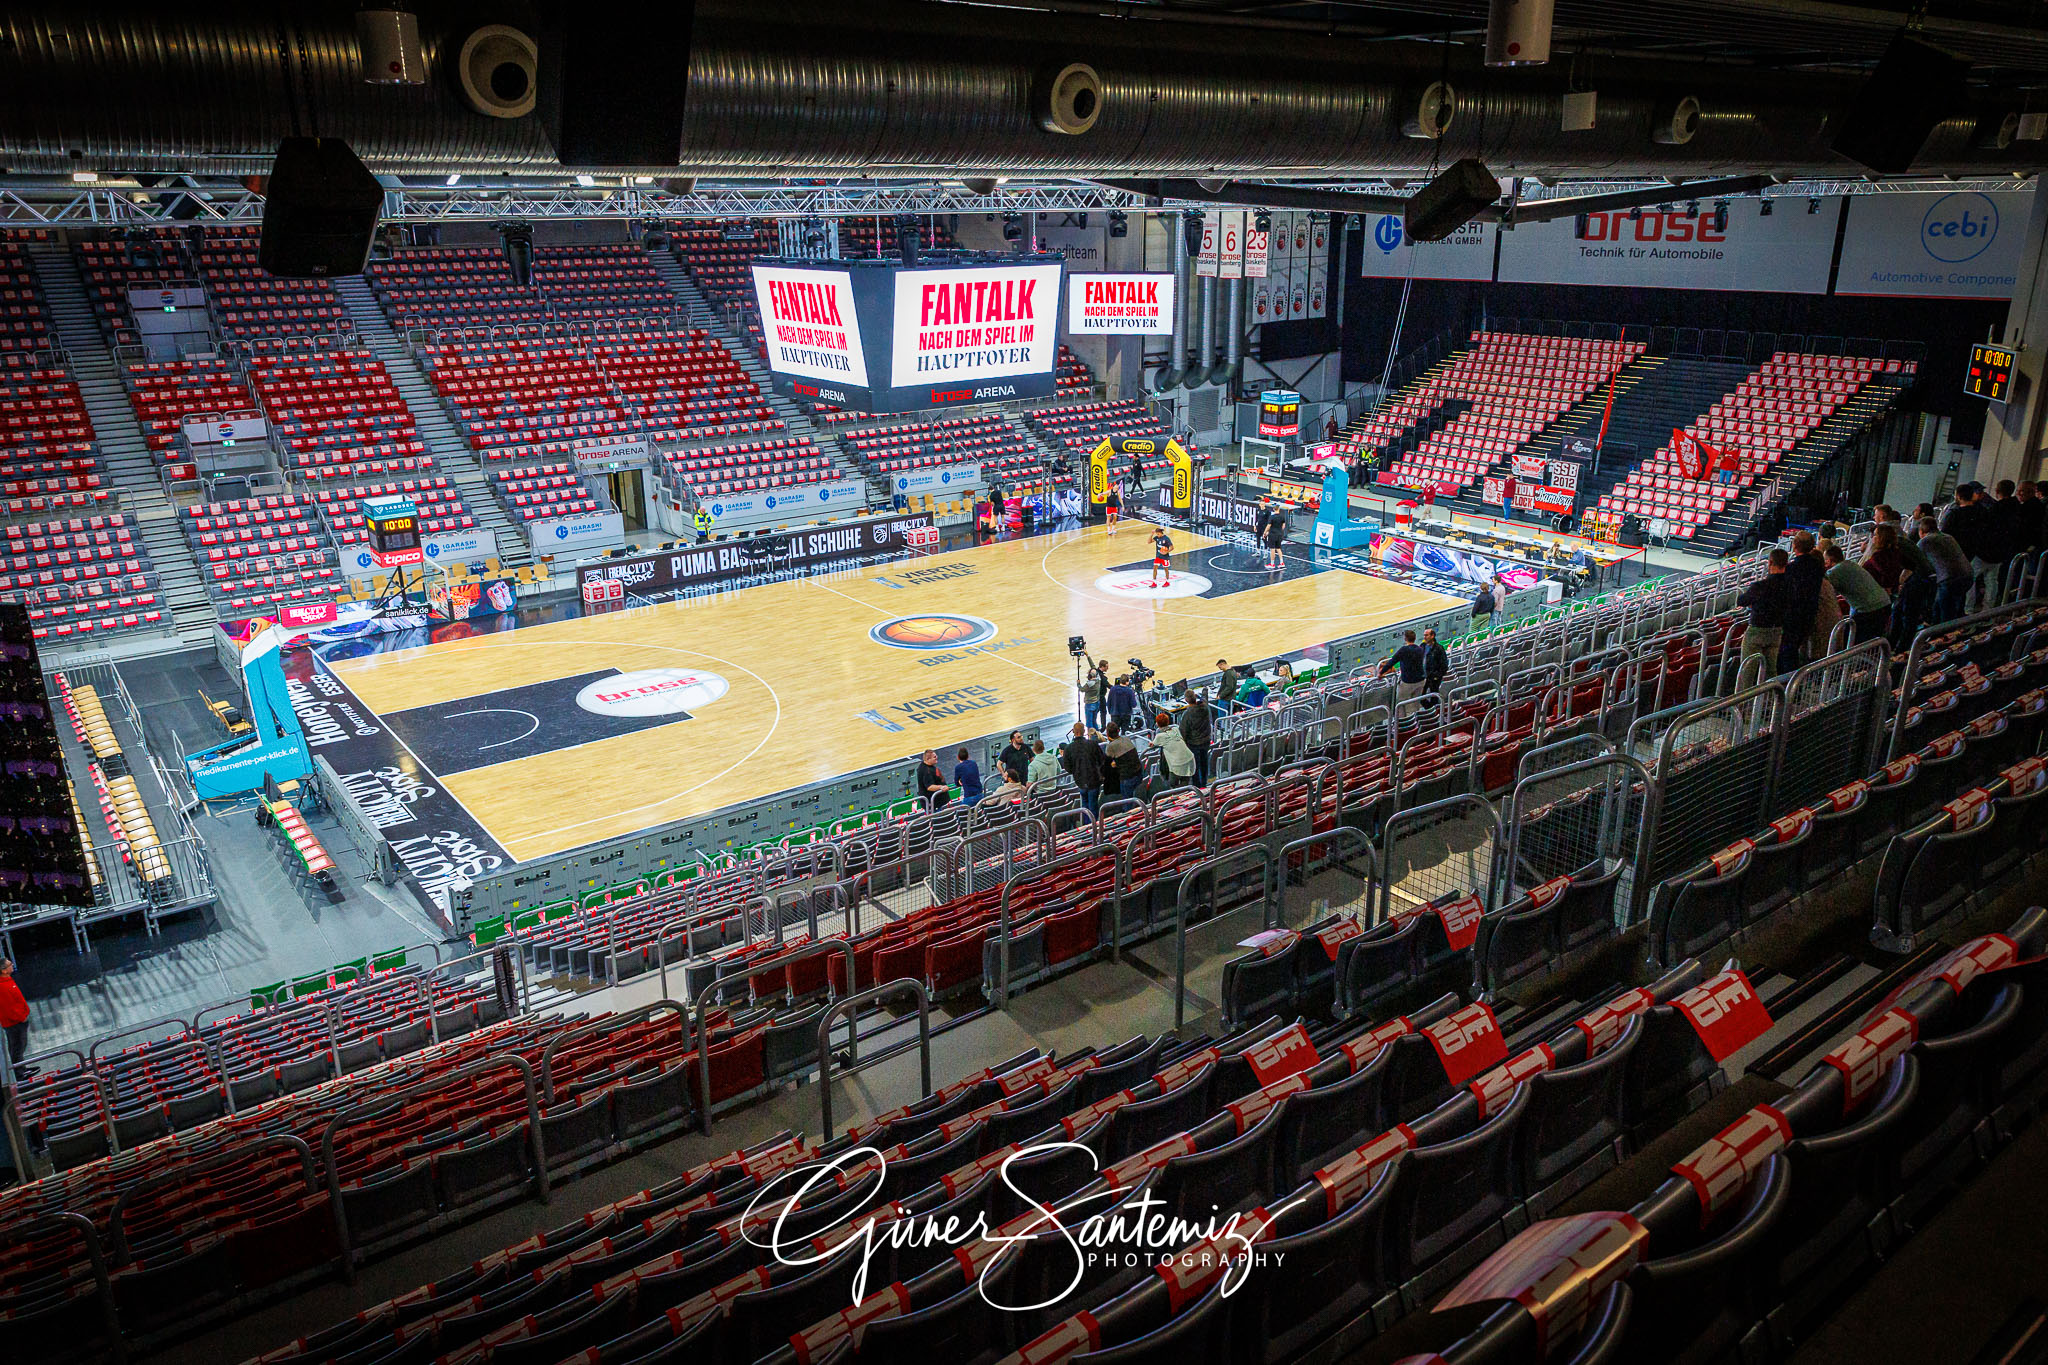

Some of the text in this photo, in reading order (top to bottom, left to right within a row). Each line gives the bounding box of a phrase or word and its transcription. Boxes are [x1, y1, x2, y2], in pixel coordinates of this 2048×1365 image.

[1928, 211, 1989, 238] cebi
[1203, 230, 1212, 250] 5
[1226, 231, 1236, 251] 6
[1247, 229, 1267, 250] 23
[1455, 237, 1483, 246] GMBH
[1221, 252, 1241, 261] brose
[1247, 251, 1267, 259] brose
[1579, 246, 1724, 260] Technik für Automobile
[1870, 271, 1943, 284] Automotive
[1085, 281, 1159, 304] FANTALK
[768, 280, 843, 327] FANTALK
[921, 279, 1037, 327] FANTALK
[1085, 306, 1159, 317] NACH DEM SPIEL IM
[1084, 318, 1158, 328] HAUPTFOYER
[776, 324, 848, 351] NACH DEM SPIEL IM
[919, 324, 1034, 351] NACH DEM SPIEL IM
[780, 346, 851, 372] HAUPTFOYER
[917, 347, 1032, 373] HAUPTFOYER
[794, 380, 846, 403] brose ARENA
[931, 384, 1016, 403] brose ARENA
[577, 446, 645, 461] brose ARENA
[1554, 462, 1578, 477] SSB
[832, 487, 857, 495] IGARASHI
[1553, 476, 1575, 489] 2012
[725, 501, 753, 510] IGARASHI
[778, 494, 805, 503] IGARASHI
[571, 522, 602, 531] IGARASHI
[442, 539, 477, 549] IGARASHI
[671, 551, 717, 579] PUMA
[808, 527, 862, 555] SCHUHE
[384, 552, 421, 566] tipico
[896, 562, 977, 580] VIERTEL
[908, 569, 980, 586] FINALE
[385, 608, 429, 618] saniklick.de
[917, 635, 1043, 668] BBL POKAL
[310, 673, 345, 697] ESSER
[595, 676, 700, 703] brose
[890, 684, 999, 714] VIERTEL
[907, 694, 1005, 724] FINALE
[196, 746, 299, 778] medikamente-per-klick.de
[375, 766, 436, 804] Store
[431, 830, 503, 877] Store
